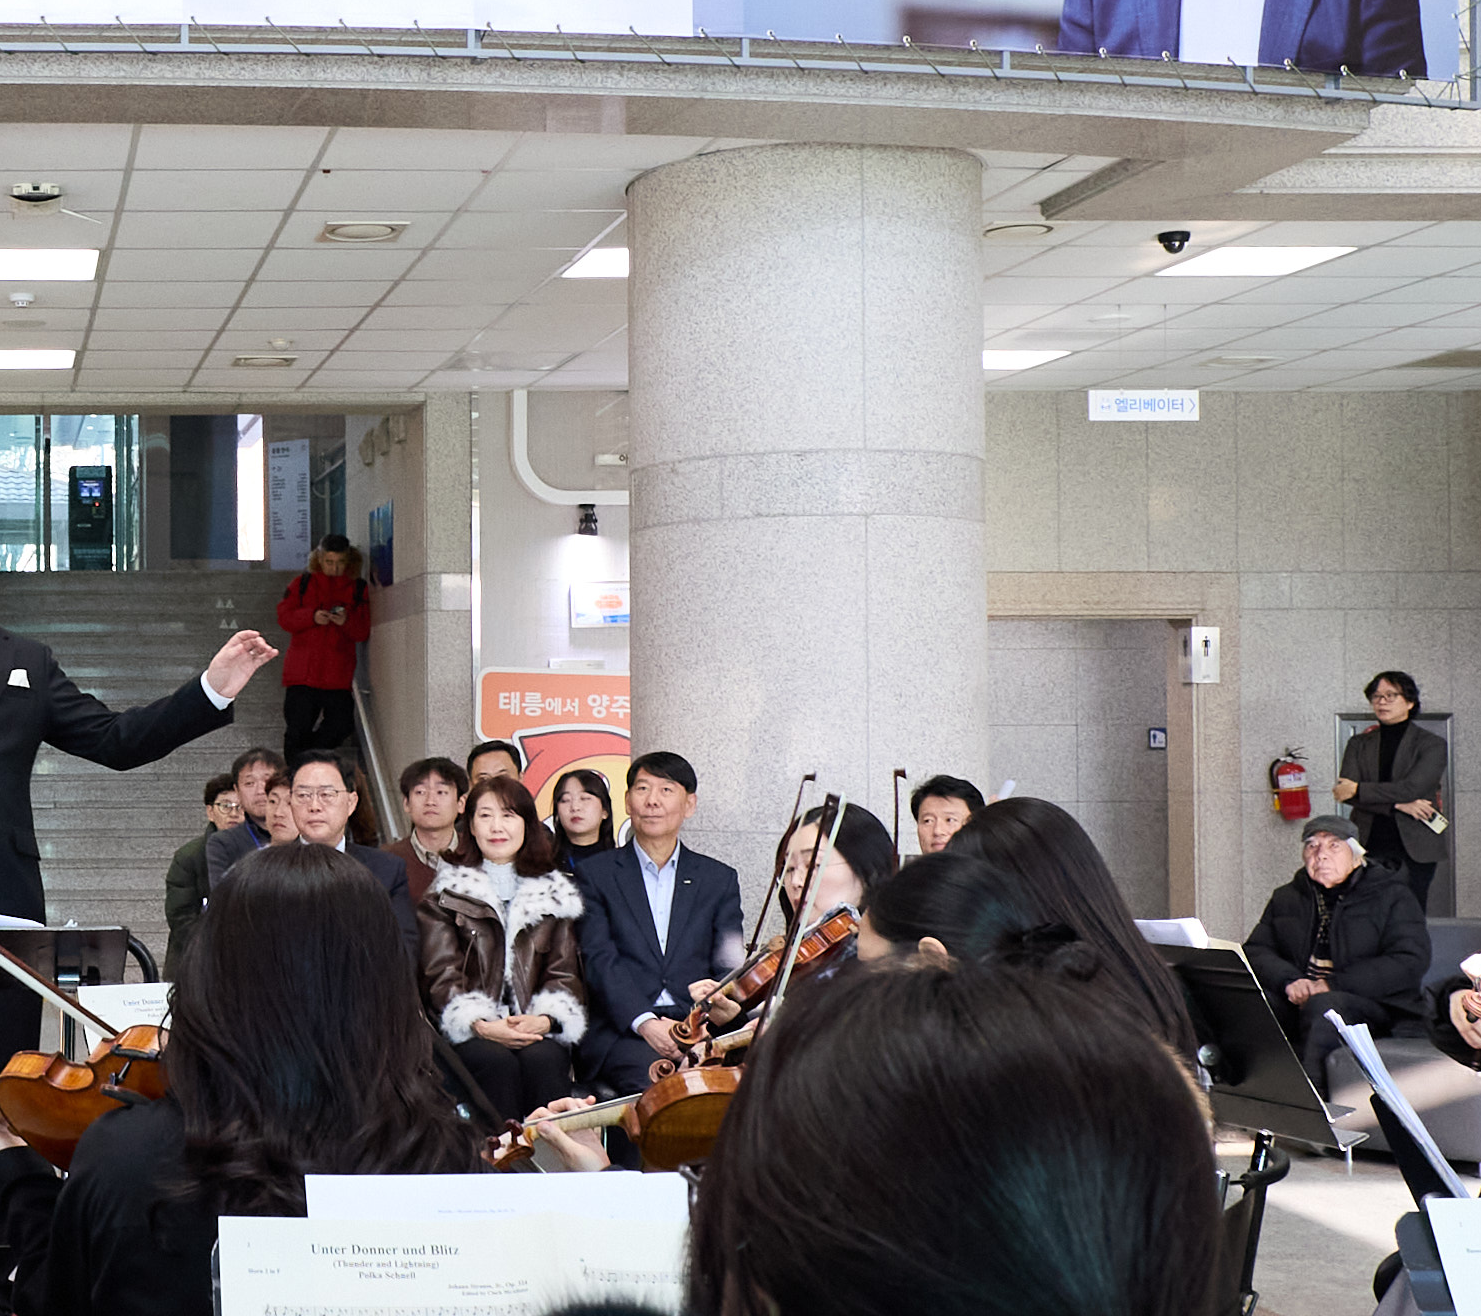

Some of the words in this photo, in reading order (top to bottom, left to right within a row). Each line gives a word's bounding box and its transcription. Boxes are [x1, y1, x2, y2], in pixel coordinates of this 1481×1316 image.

[1114, 397, 1185, 413] 엘리베이터
[498, 691, 579, 717] 태릉에서
[310, 1243, 347, 1256] Unter
[351, 1244, 398, 1256] Donner
[402, 1244, 426, 1256] und
[430, 1244, 460, 1256] Blitz
[333, 1260, 373, 1269] (Thunder
[376, 1260, 391, 1268] and
[394, 1260, 440, 1270] Lightning)
[358, 1271, 383, 1280] Polka
[385, 1271, 416, 1280] Schnell
